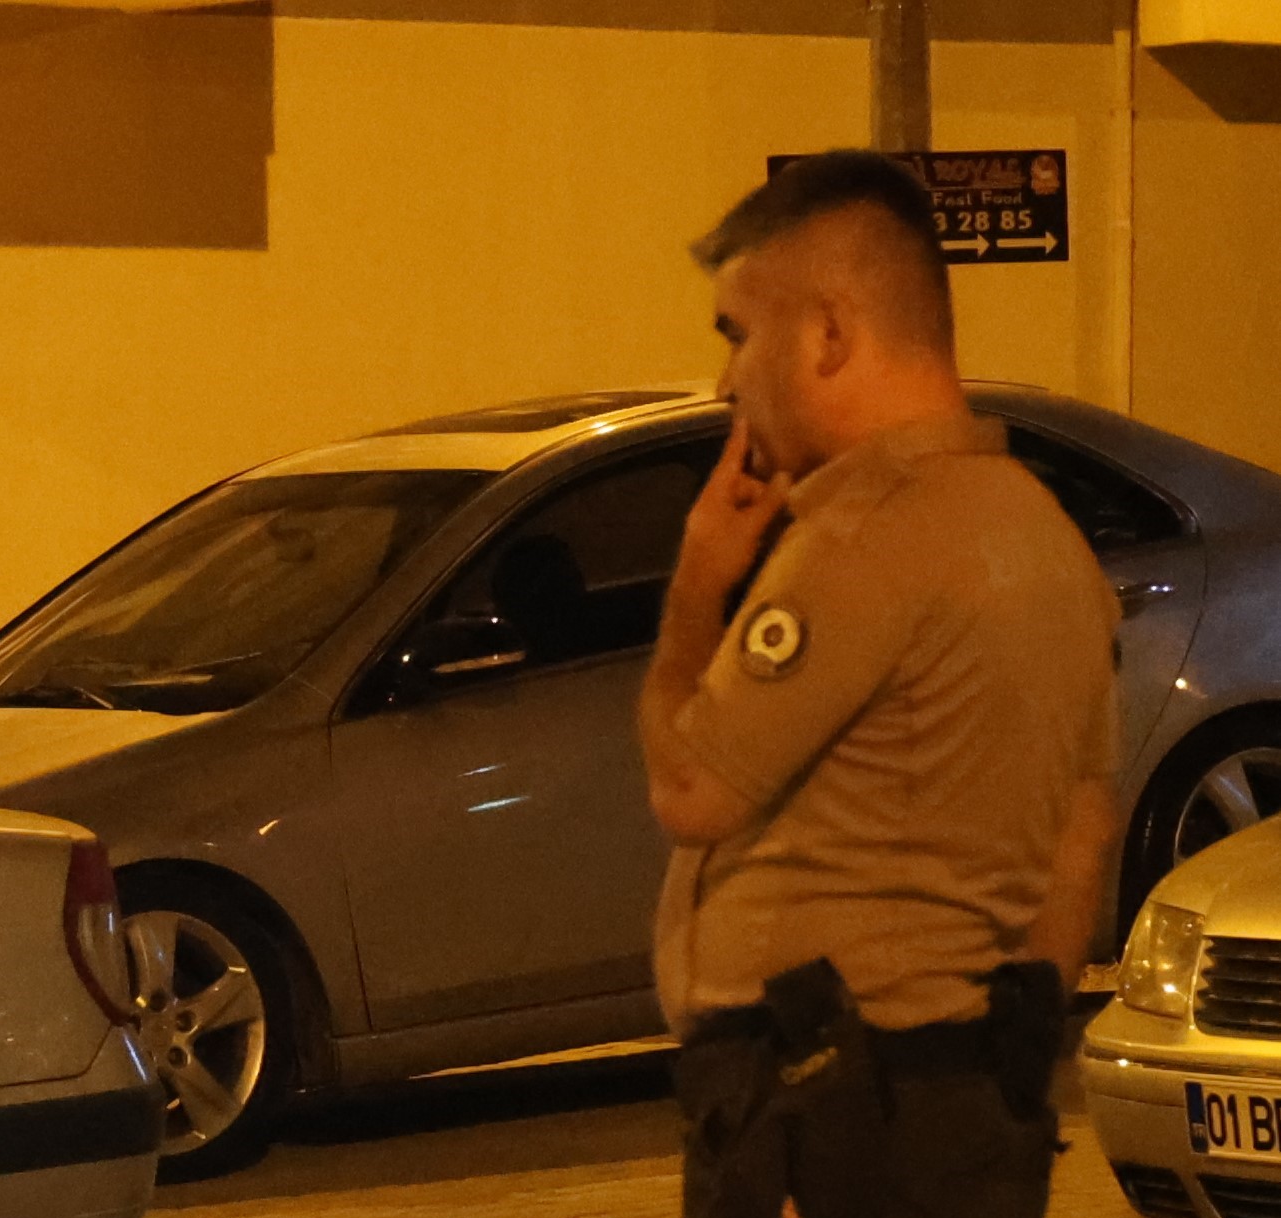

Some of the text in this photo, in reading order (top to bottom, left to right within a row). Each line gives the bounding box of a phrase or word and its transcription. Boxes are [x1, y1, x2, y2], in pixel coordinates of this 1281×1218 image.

[957, 210, 989, 232] 28
[1000, 209, 1032, 230] 85
[1207, 1092, 1281, 1152] 01 B
